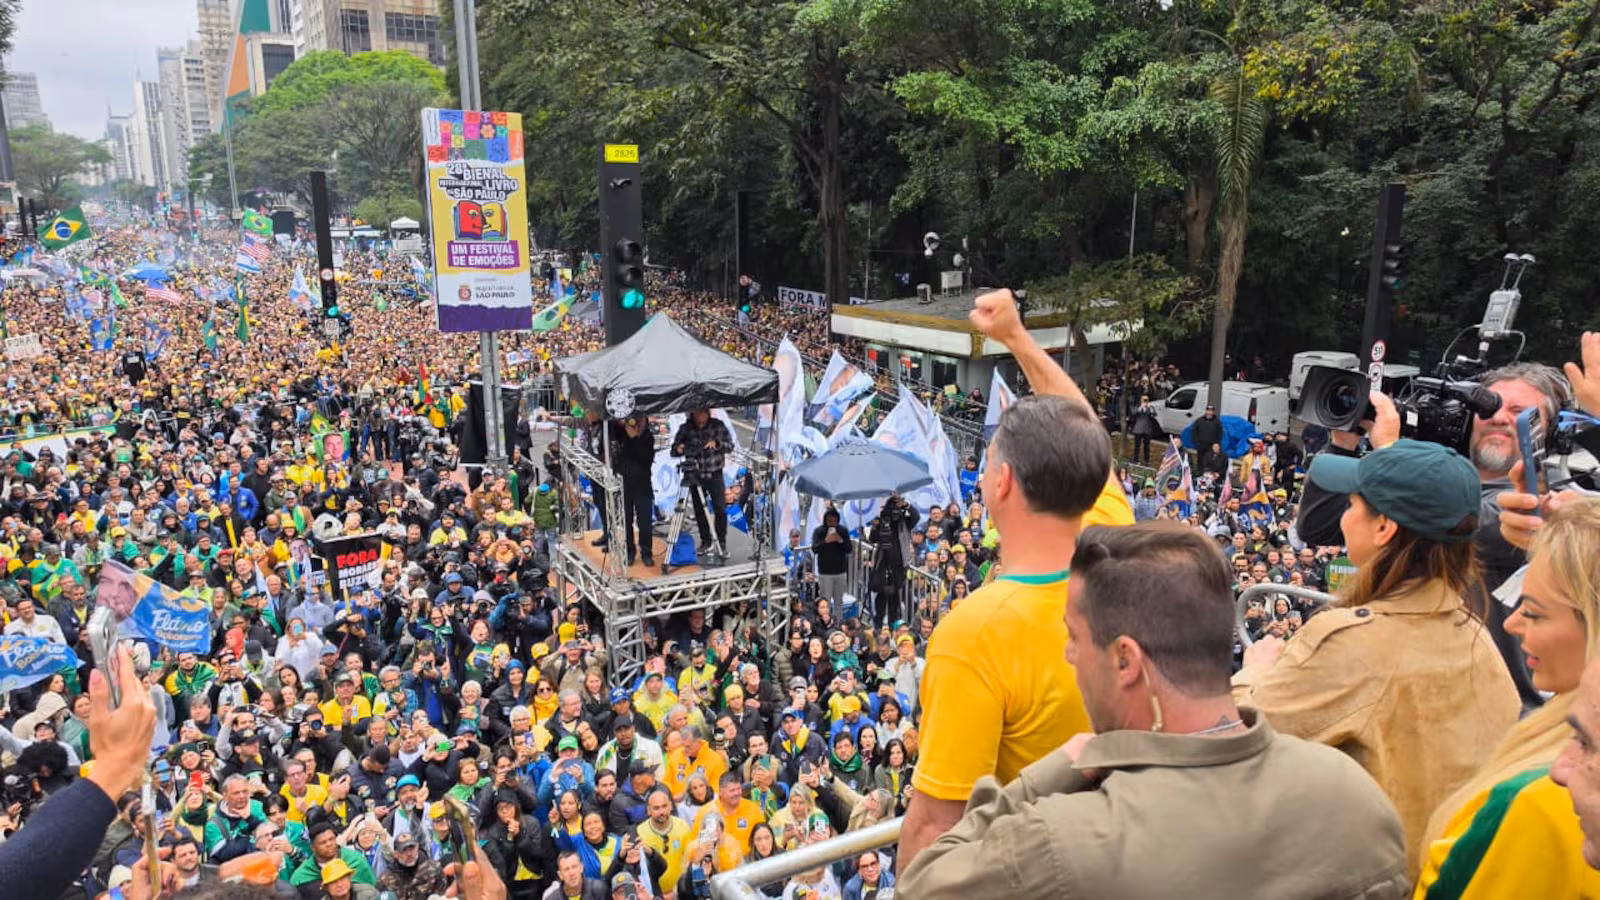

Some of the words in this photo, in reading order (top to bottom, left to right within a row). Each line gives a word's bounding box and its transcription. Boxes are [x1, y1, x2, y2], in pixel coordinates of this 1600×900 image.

[463, 168, 505, 181] BIENAL
[485, 178, 518, 191] LIVRO
[454, 187, 474, 199] SÃO
[475, 189, 506, 201] PAULO
[451, 244, 468, 255] UM
[469, 243, 515, 255] FESTIVAL
[453, 255, 466, 266] DE
[468, 254, 515, 268] EMOÇÕES
[781, 289, 815, 307] FORA
[336, 548, 378, 570] FORA
